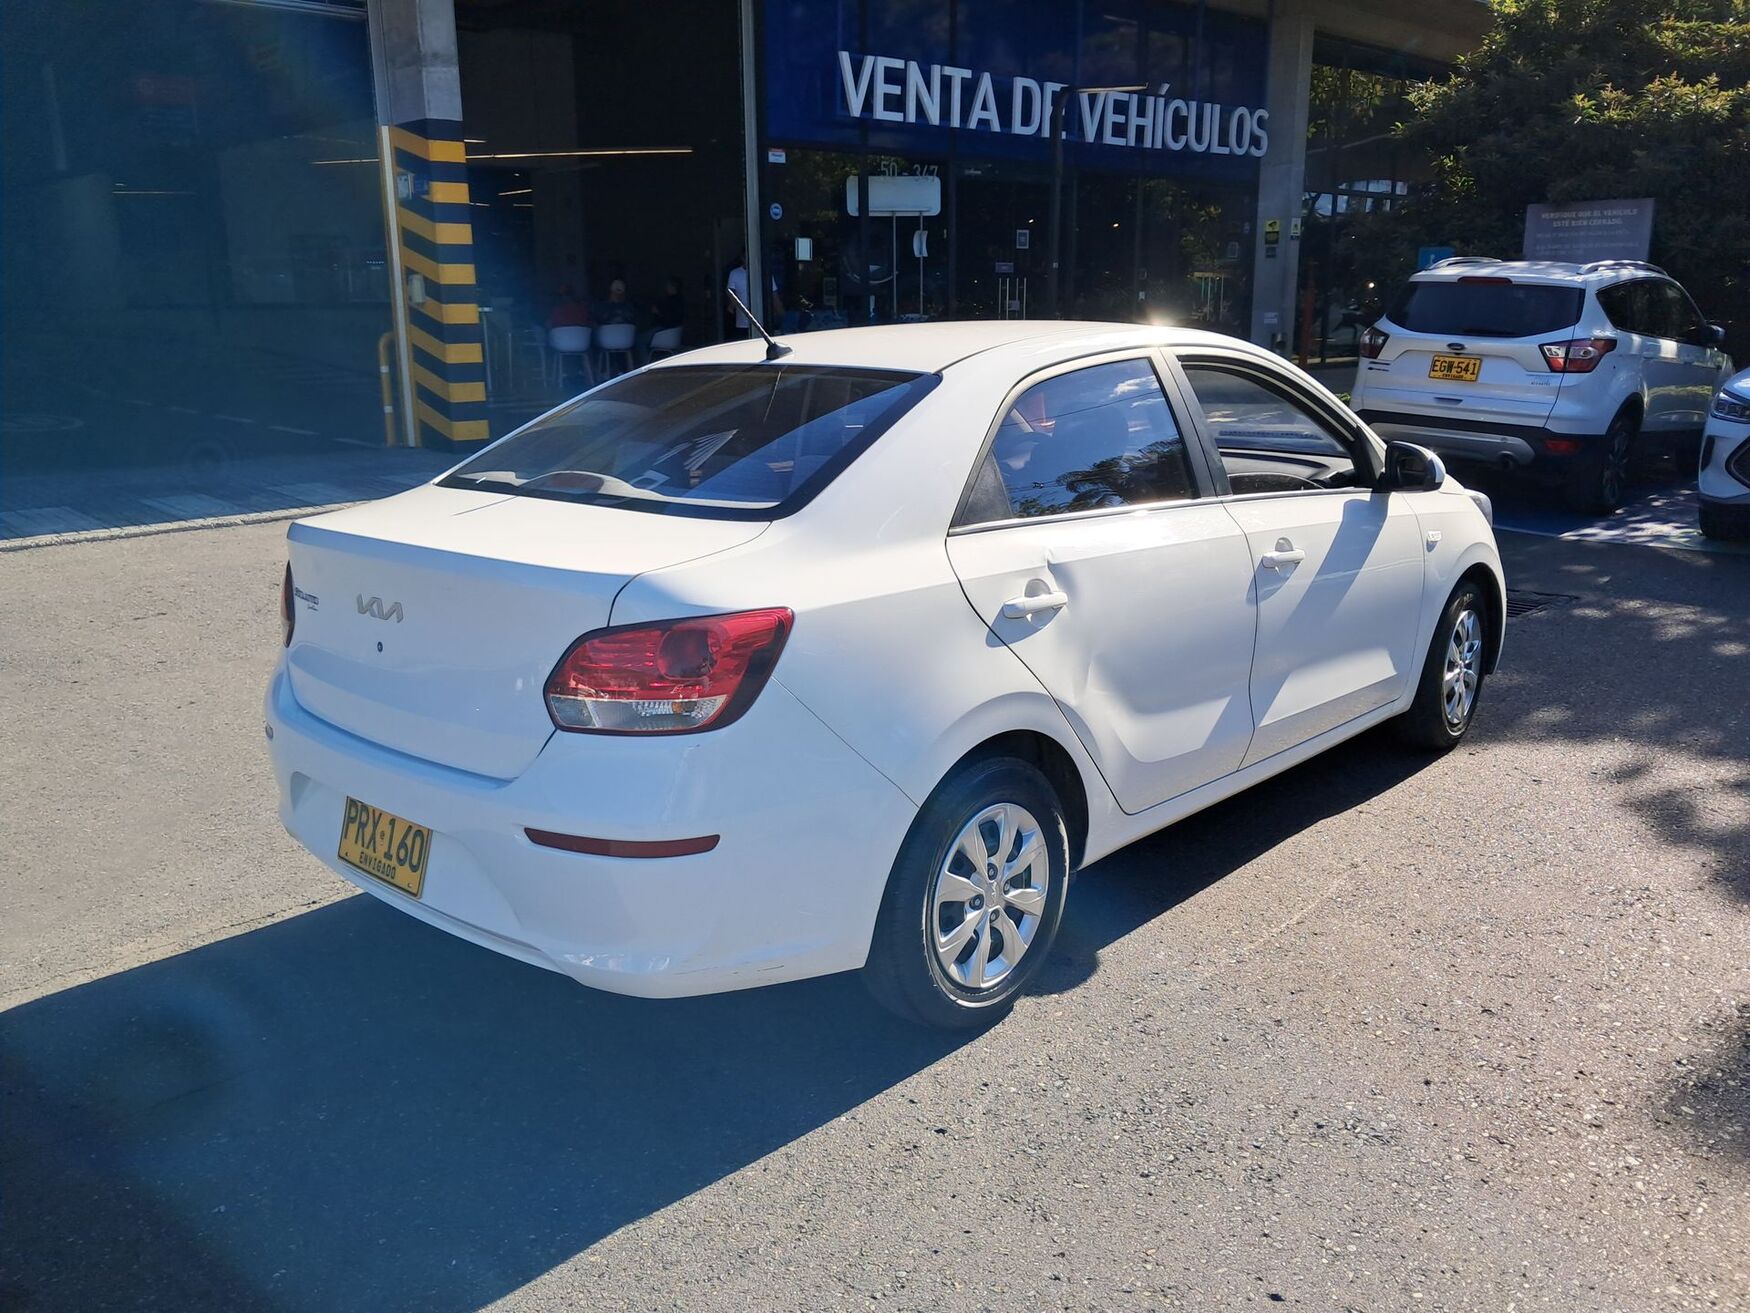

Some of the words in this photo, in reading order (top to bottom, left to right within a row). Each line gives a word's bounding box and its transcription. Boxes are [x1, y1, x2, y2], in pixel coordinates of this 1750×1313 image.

[838, 51, 1000, 132] VENTA
[1079, 82, 1269, 158] VEHÍCULOS
[356, 593, 404, 624] KIA
[359, 851, 397, 880] ENVIGADO
